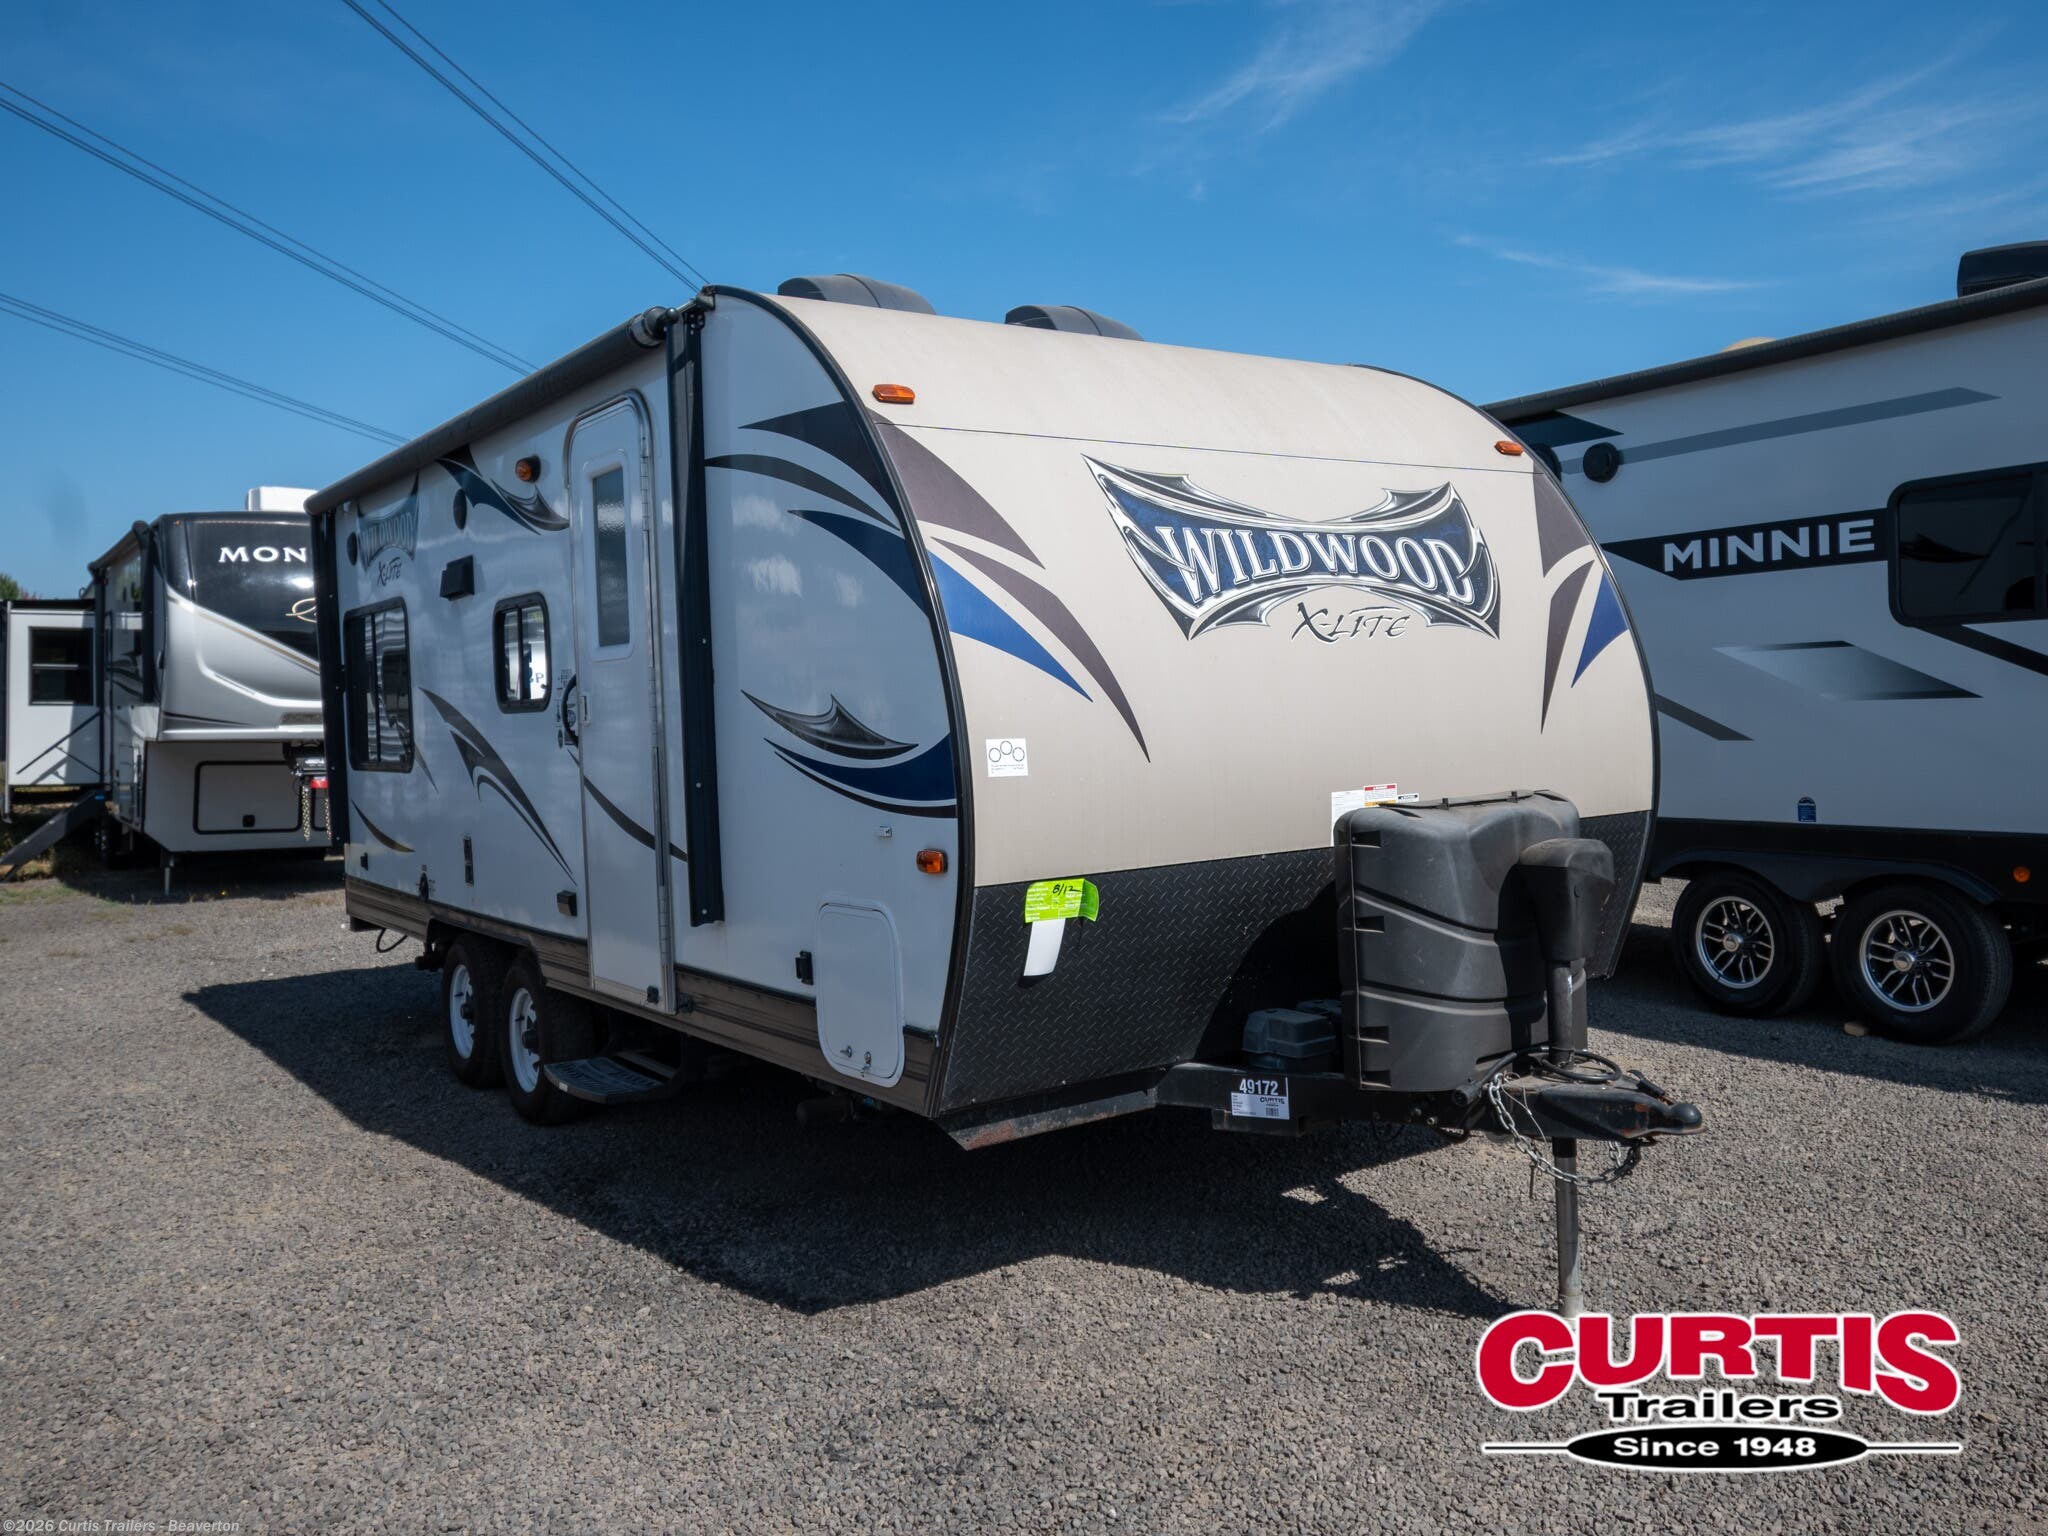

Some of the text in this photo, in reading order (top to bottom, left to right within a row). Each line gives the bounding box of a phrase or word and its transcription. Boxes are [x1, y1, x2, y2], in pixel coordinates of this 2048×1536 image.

[1155, 525, 1475, 605] WILDWOOD
[1664, 519, 1875, 572] MINNIE
[1291, 602, 1410, 642] X-LITE
[1239, 1078, 1279, 1096] 49172
